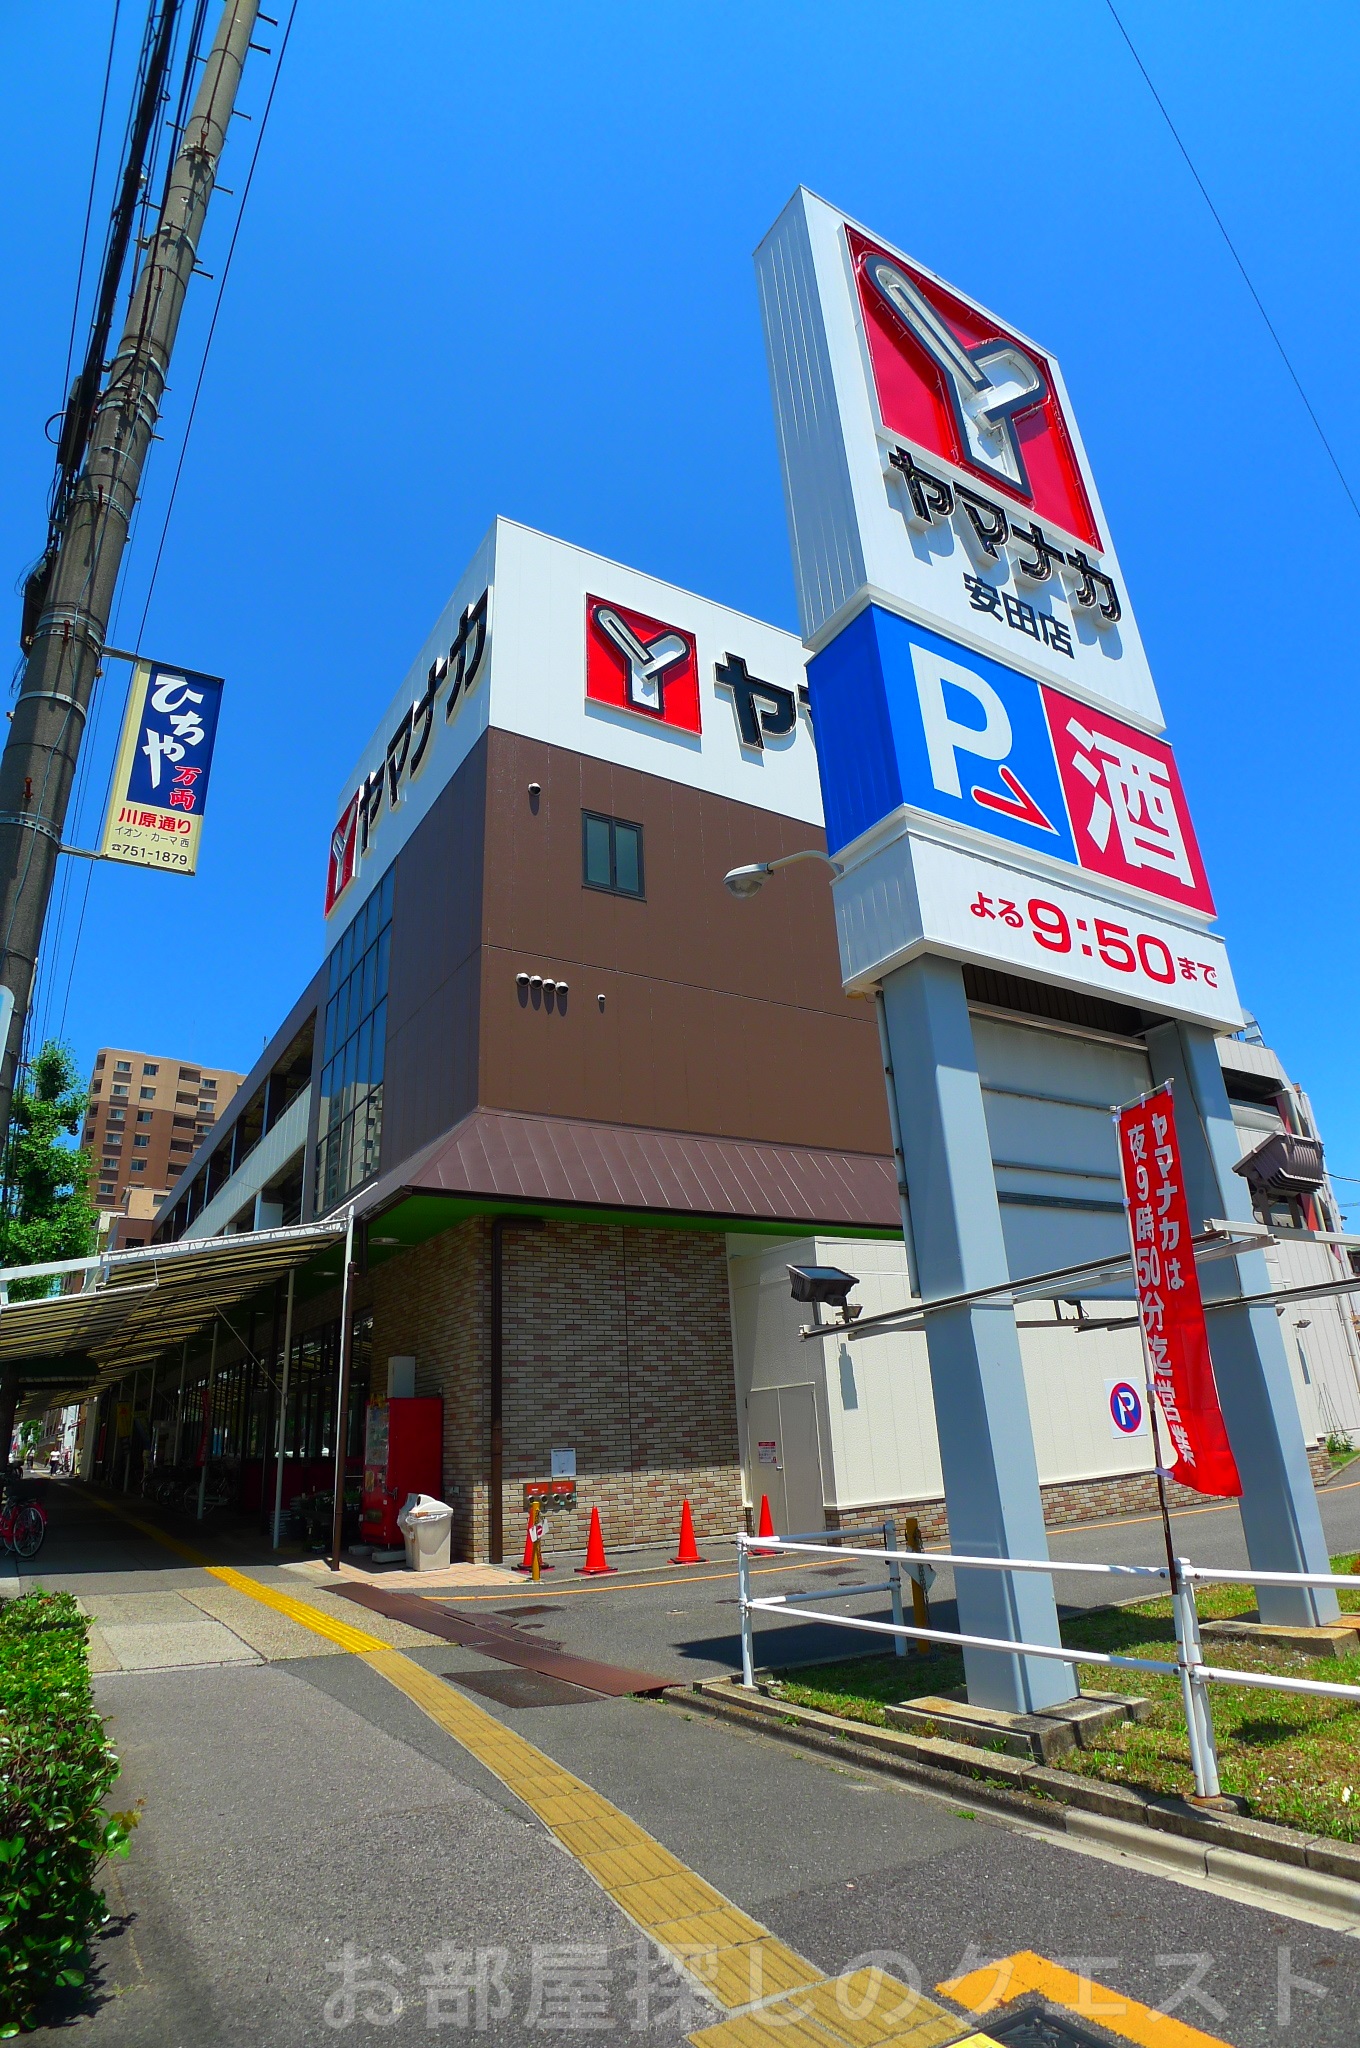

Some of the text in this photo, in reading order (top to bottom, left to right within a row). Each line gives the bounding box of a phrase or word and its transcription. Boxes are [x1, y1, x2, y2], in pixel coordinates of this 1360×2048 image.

[884, 445, 1121, 626] ヤマナカ
[963, 573, 1075, 660] 安田店
[142, 674, 204, 789] ひちや
[357, 585, 489, 858] ヤマナカ
[713, 651, 812, 750] ヤ
[909, 642, 1013, 799] P
[118, 807, 191, 834] 川原通り
[169, 765, 202, 811] 万両
[1065, 716, 1196, 888] 酒
[122, 844, 188, 865] 751-1879
[970, 891, 1218, 989] よる9:50まで
[1151, 1112, 1185, 1291] ヤマナカは
[1126, 1123, 1196, 1468] 夜9時50分迄営業
